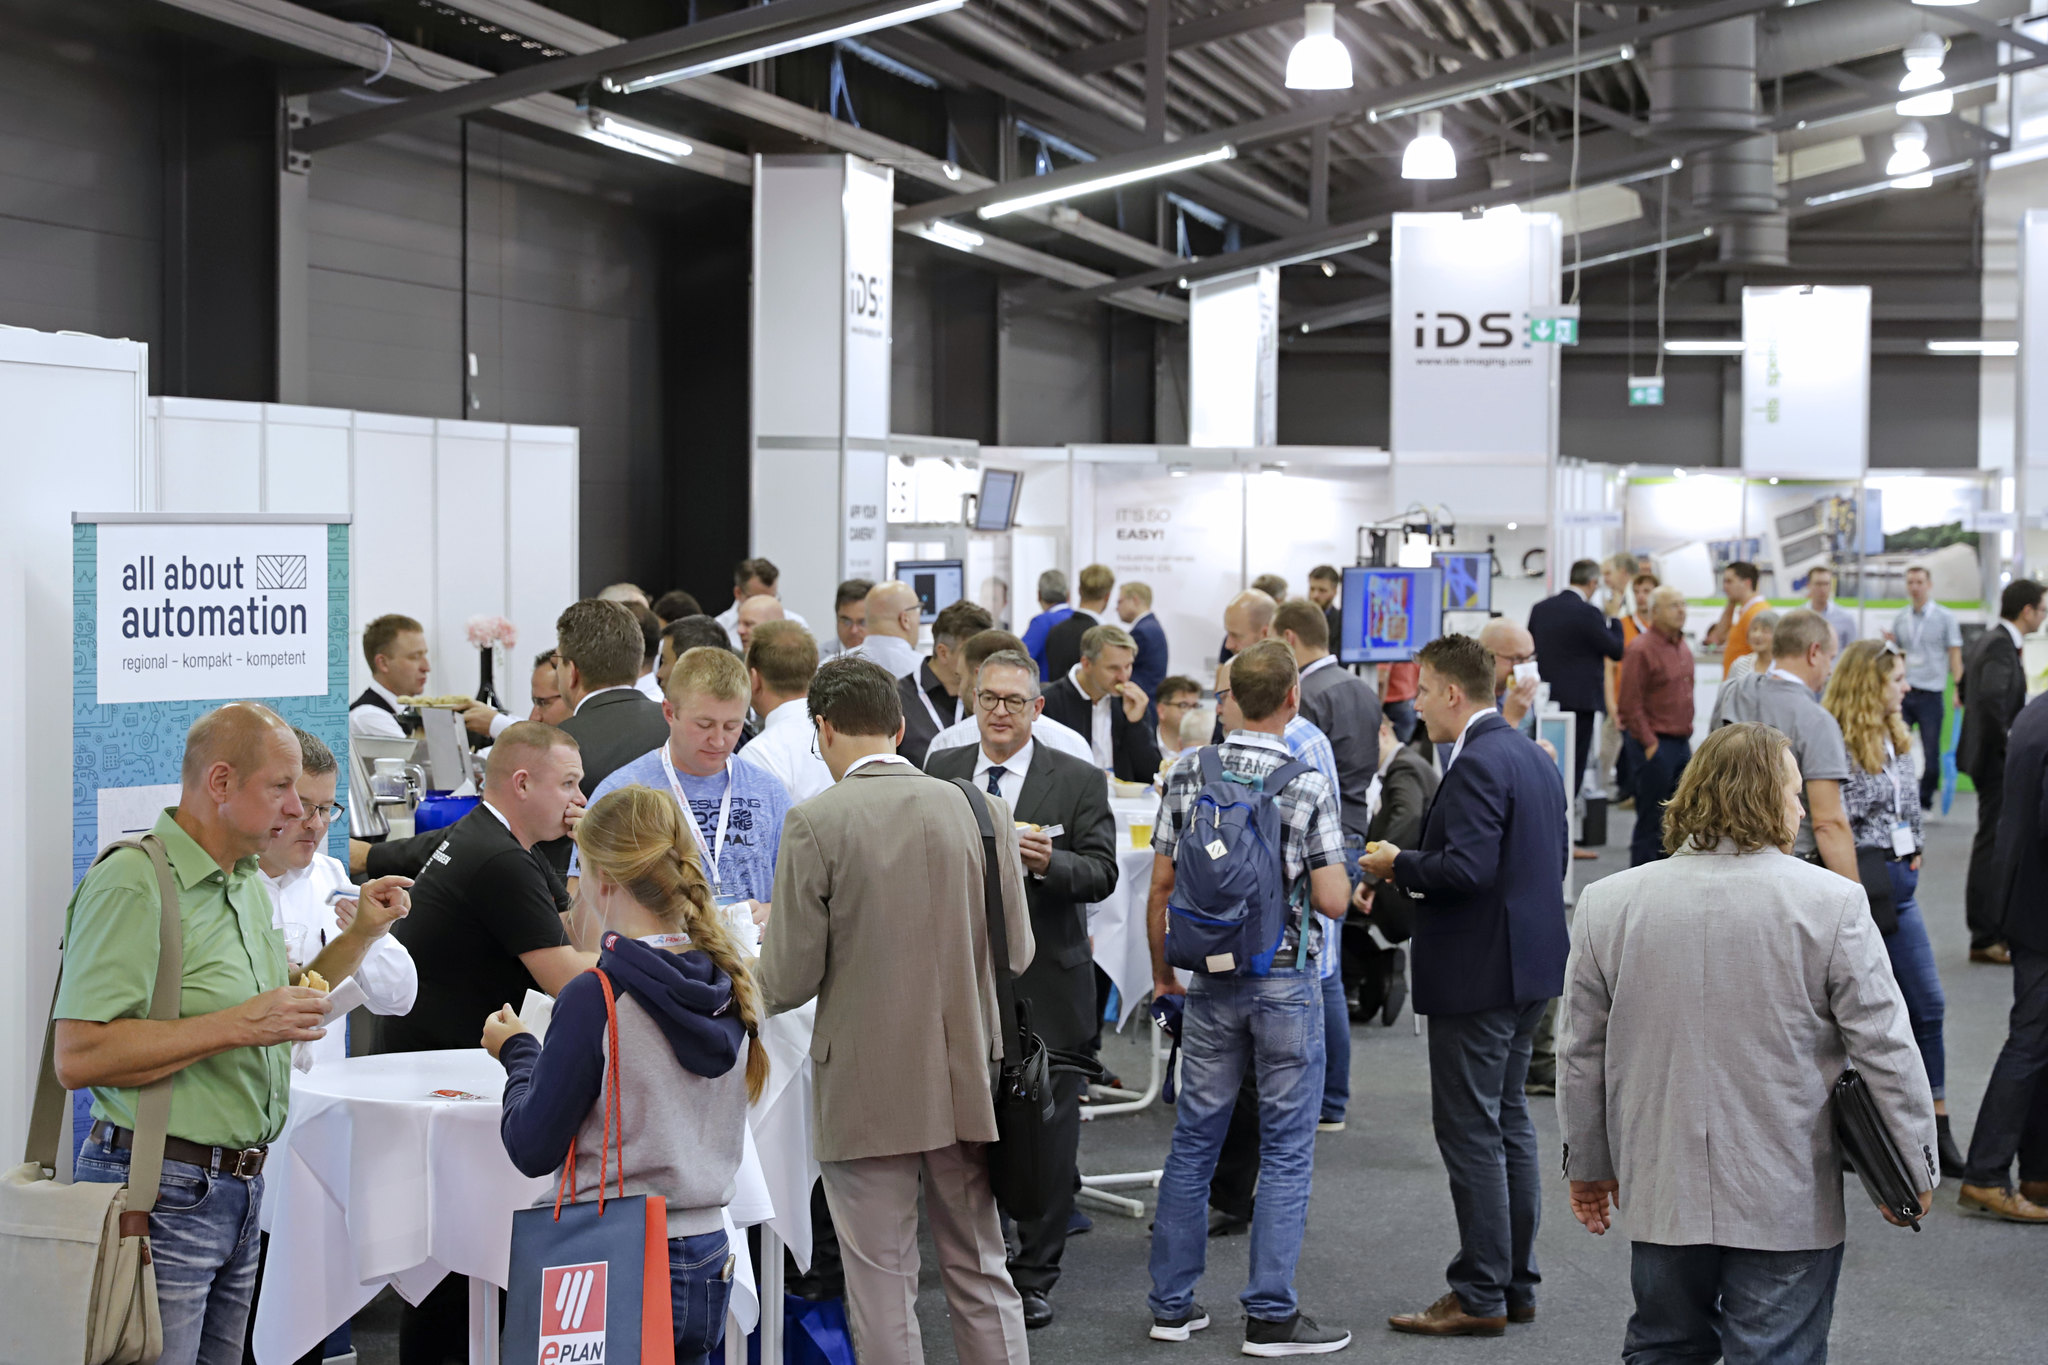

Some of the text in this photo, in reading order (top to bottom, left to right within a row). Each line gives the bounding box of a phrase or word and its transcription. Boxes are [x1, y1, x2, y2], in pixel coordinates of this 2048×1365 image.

[122, 555, 244, 591] all about
[121, 595, 307, 638] automation
[122, 653, 168, 673] regional
[182, 652, 233, 671] kompakt
[246, 650, 306, 669] kompetent
